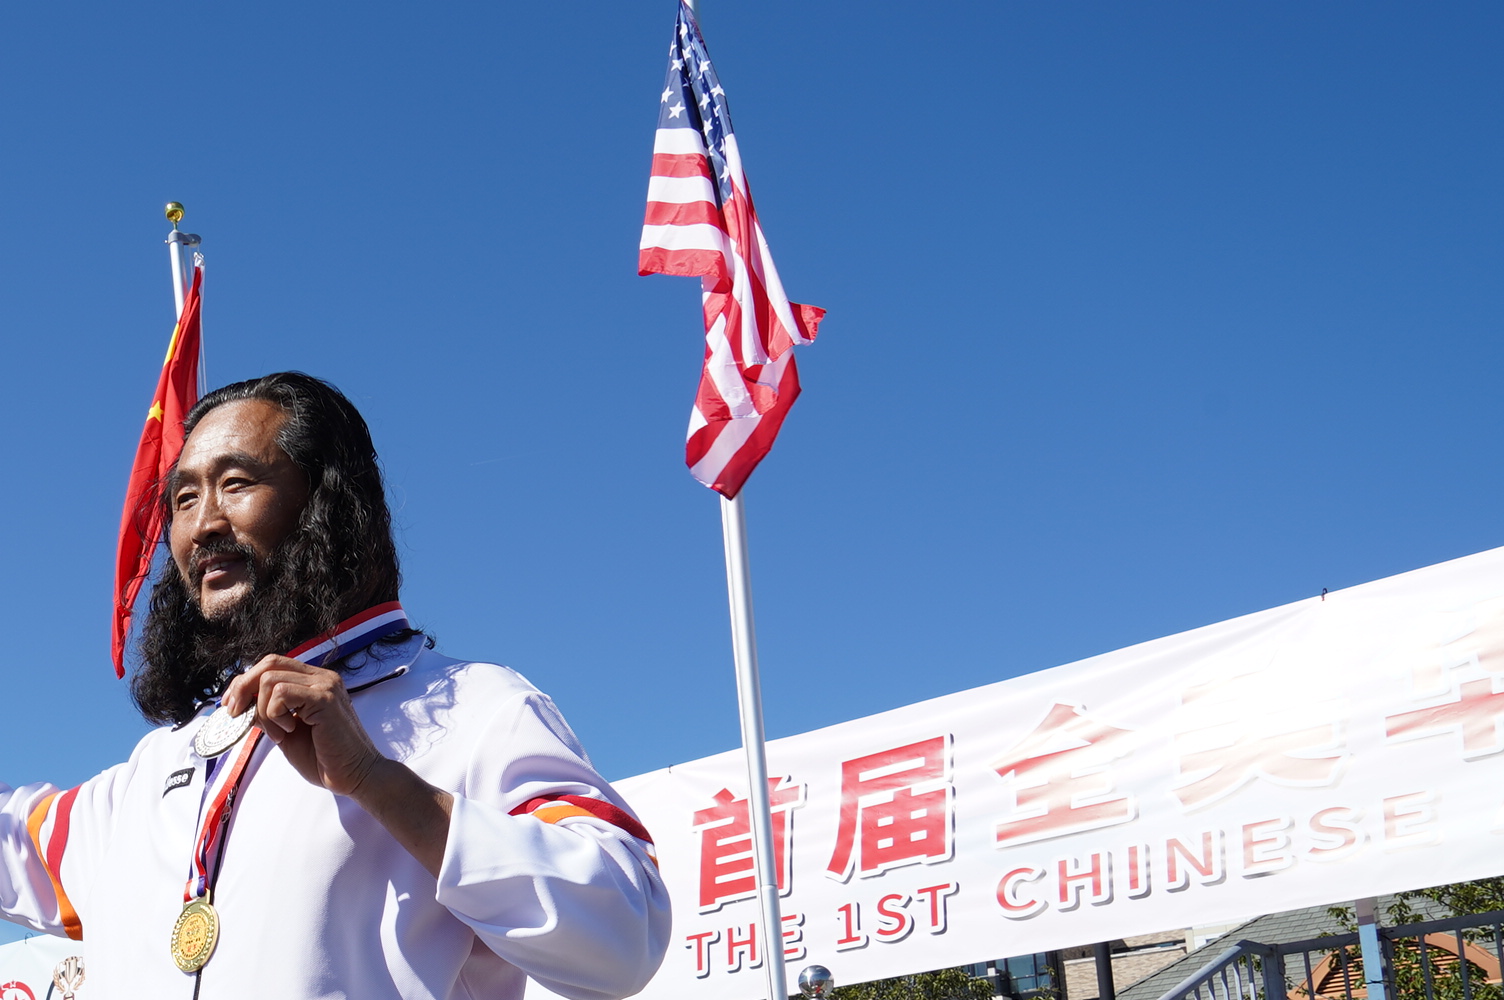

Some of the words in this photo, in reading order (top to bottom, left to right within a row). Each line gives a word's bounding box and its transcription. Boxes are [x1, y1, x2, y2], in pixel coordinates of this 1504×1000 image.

[685, 913, 801, 972] THE
[836, 882, 952, 946] 1ST
[995, 789, 1434, 912] CHINESE
